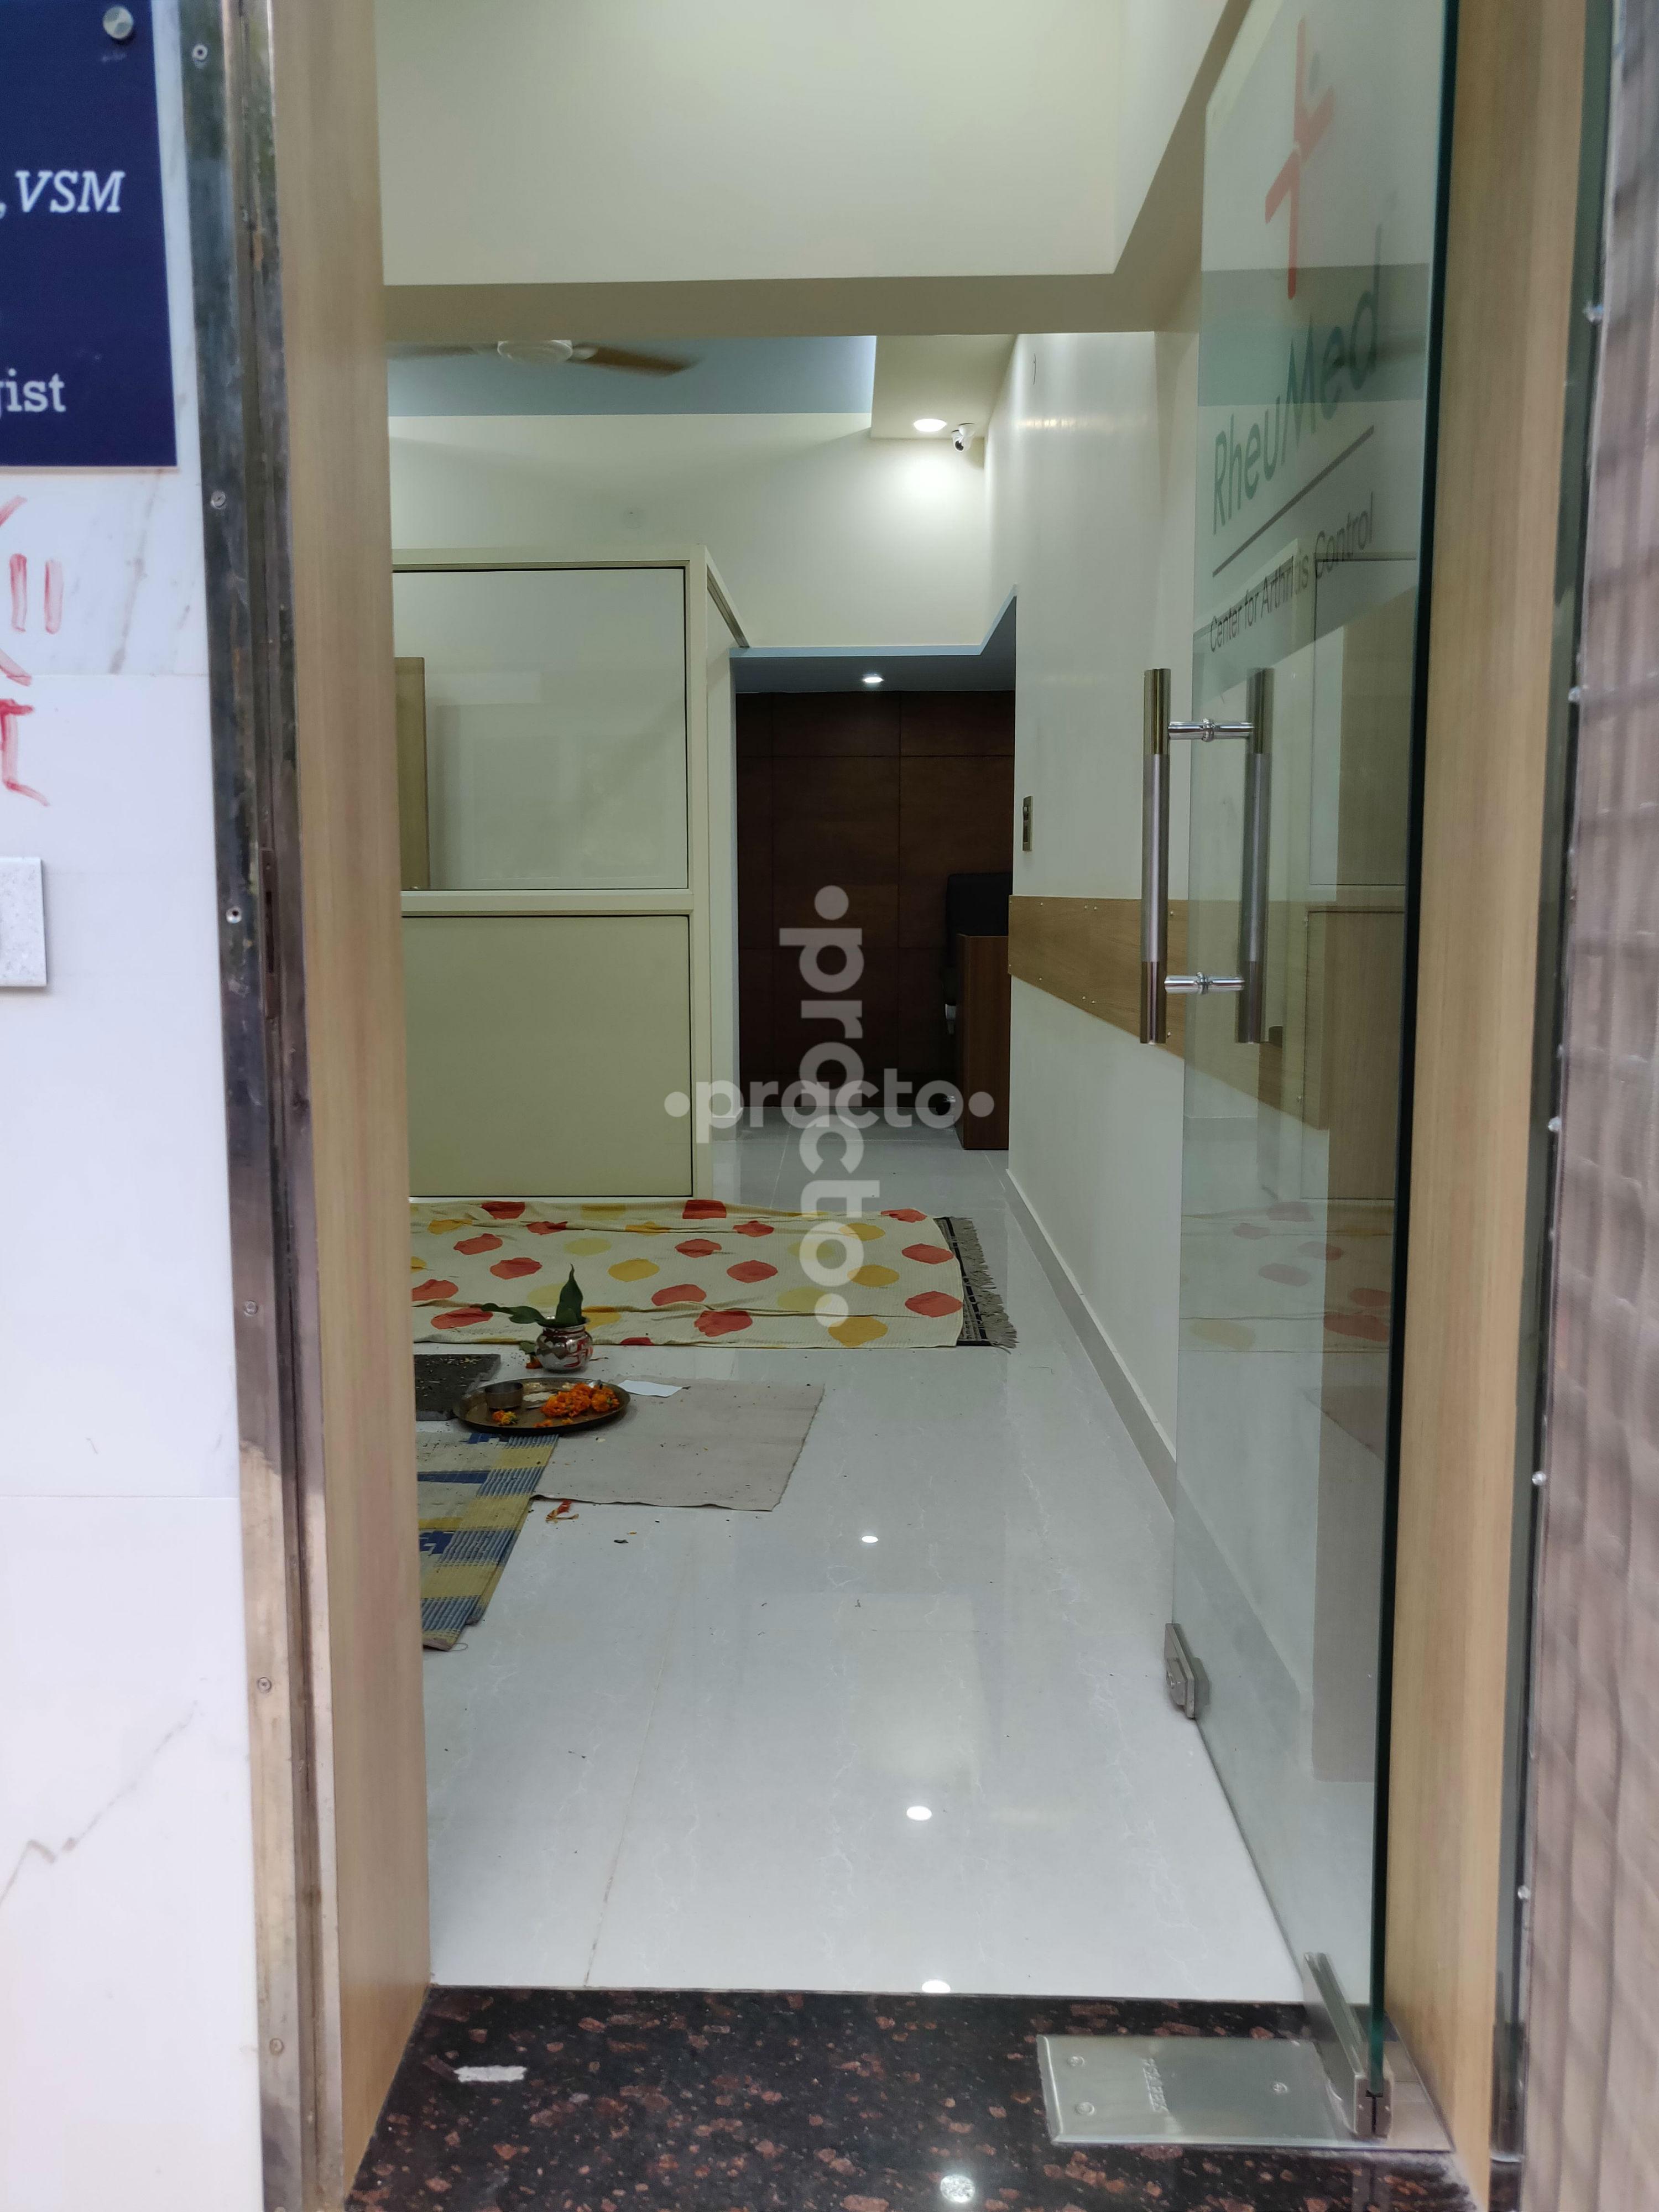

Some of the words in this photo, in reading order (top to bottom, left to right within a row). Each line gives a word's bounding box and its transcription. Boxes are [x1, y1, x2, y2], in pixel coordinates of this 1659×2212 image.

[0, 368, 66, 414] ist
[1213, 224, 1382, 536] RheuMed
[1210, 607, 1242, 653] Center
[1245, 588, 1259, 630] for
[1314, 491, 1373, 580] Control
